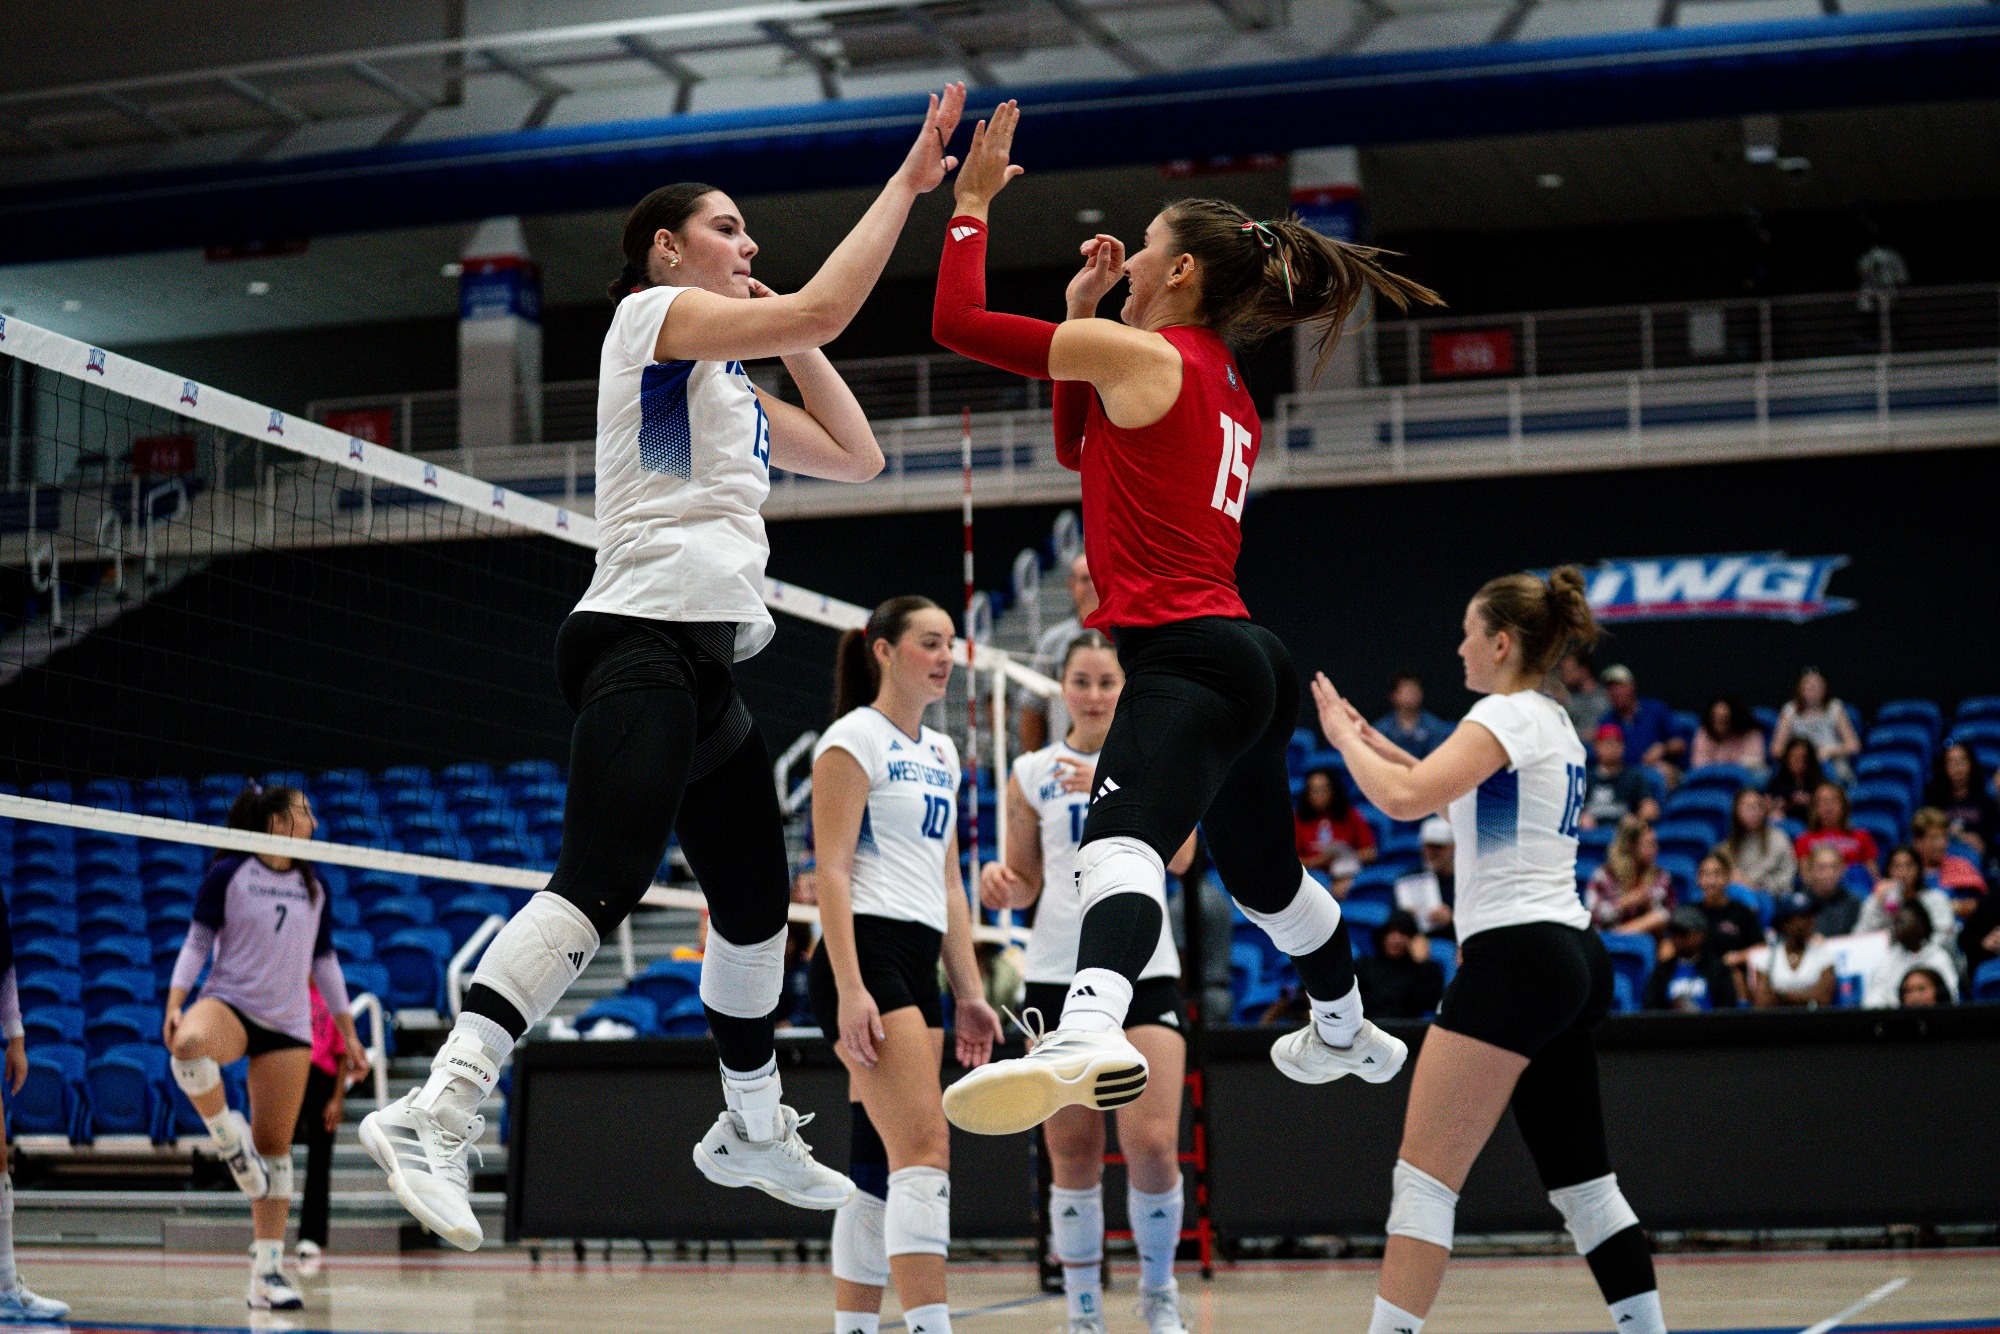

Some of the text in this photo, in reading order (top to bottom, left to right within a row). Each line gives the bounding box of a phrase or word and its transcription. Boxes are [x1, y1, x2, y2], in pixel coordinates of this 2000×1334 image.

[1211, 411, 1252, 523] 15
[922, 794, 950, 839] 10
[1069, 803, 1090, 842] 1
[1559, 763, 1584, 837] 18
[275, 904, 287, 932] 7
